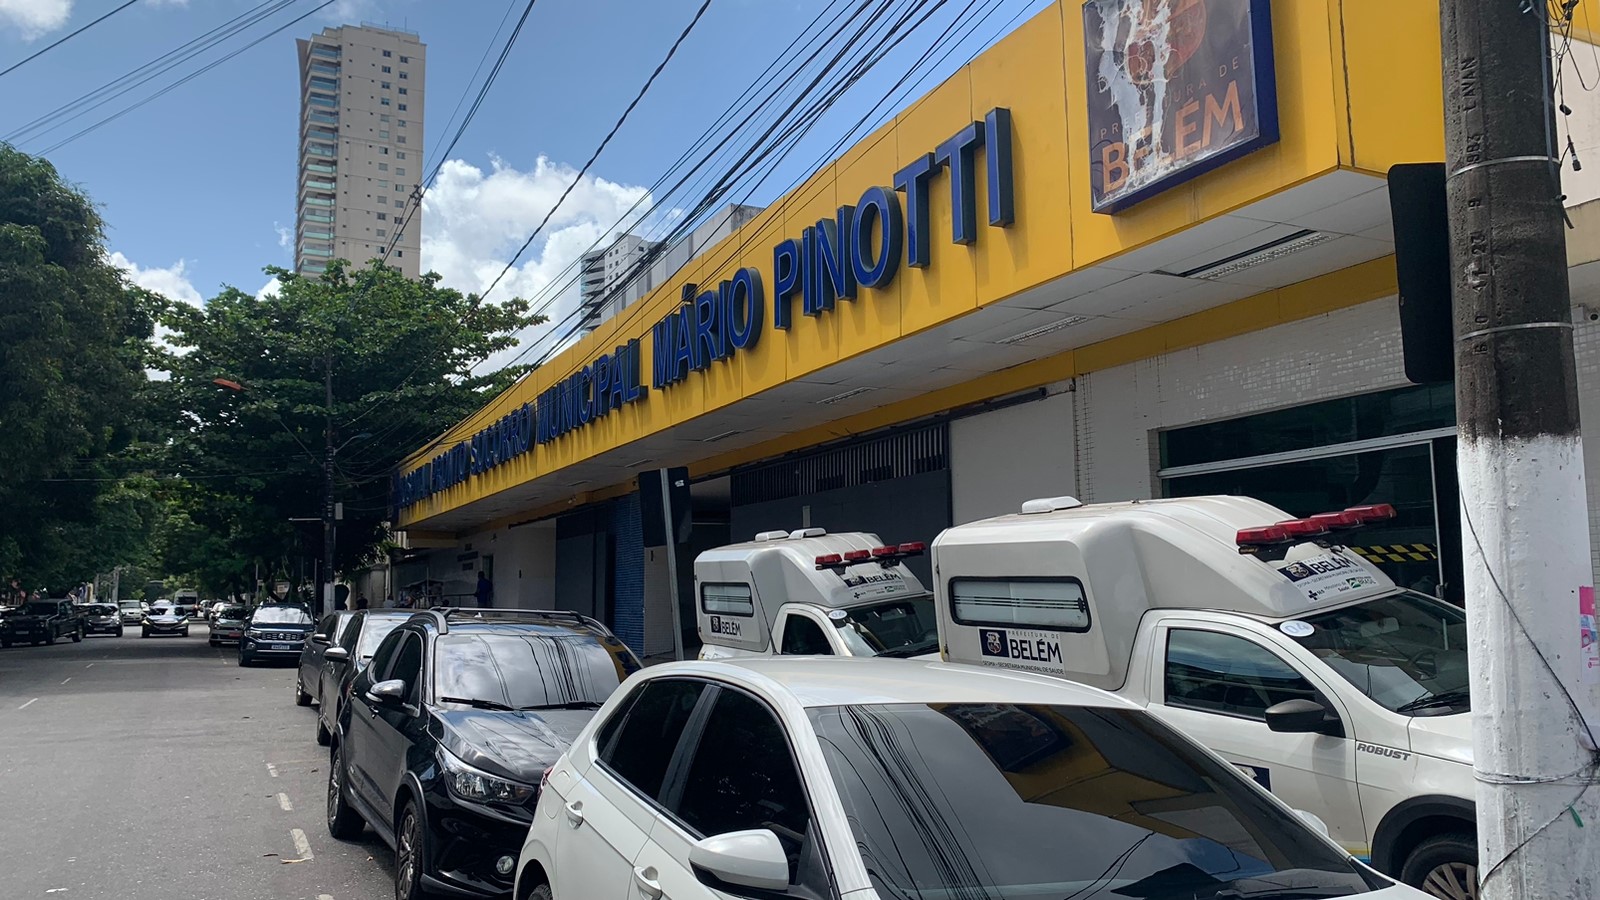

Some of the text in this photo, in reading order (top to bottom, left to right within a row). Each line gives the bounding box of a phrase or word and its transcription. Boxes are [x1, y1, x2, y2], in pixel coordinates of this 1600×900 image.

[1100, 56, 1239, 139] PREFETURA DE
[1102, 80, 1244, 194] BELÉM
[536, 338, 648, 445] MUNICIPAL
[652, 266, 764, 390] MÁRIO
[773, 107, 1015, 330] PINOTTI
[1007, 630, 1048, 639] PREFEITURA
[1009, 638, 1063, 664] BELÉM
[1356, 742, 1412, 761] ROBUST
